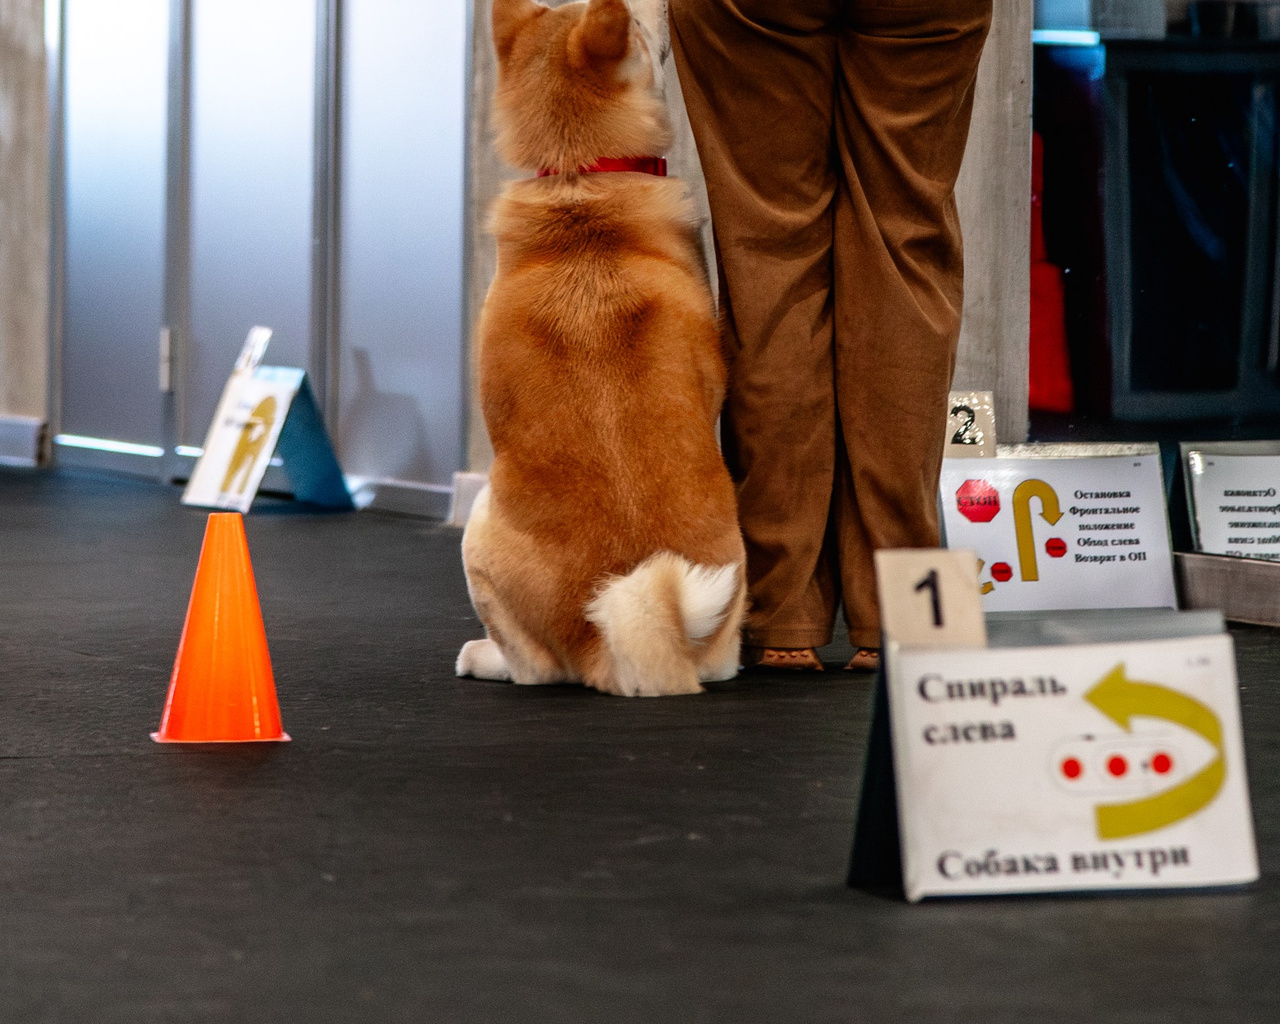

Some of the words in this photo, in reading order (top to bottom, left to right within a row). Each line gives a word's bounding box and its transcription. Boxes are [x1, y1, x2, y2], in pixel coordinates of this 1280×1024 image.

[950, 404, 977, 445] 2
[957, 495, 998, 507] СТОП
[1074, 490, 1131, 499] Остановка
[1069, 506, 1141, 517] Фронтальное
[1078, 522, 1136, 531] положение
[1077, 537, 1108, 547] Обход
[1111, 537, 1140, 546] слева
[1074, 553, 1116, 565] Возврат
[1128, 551, 1147, 562] ОП
[914, 568, 945, 629] 1
[918, 674, 1068, 706] Спираль
[923, 721, 1017, 745] слева
[936, 849, 1060, 881] Собака
[1071, 845, 1191, 878] внутри
